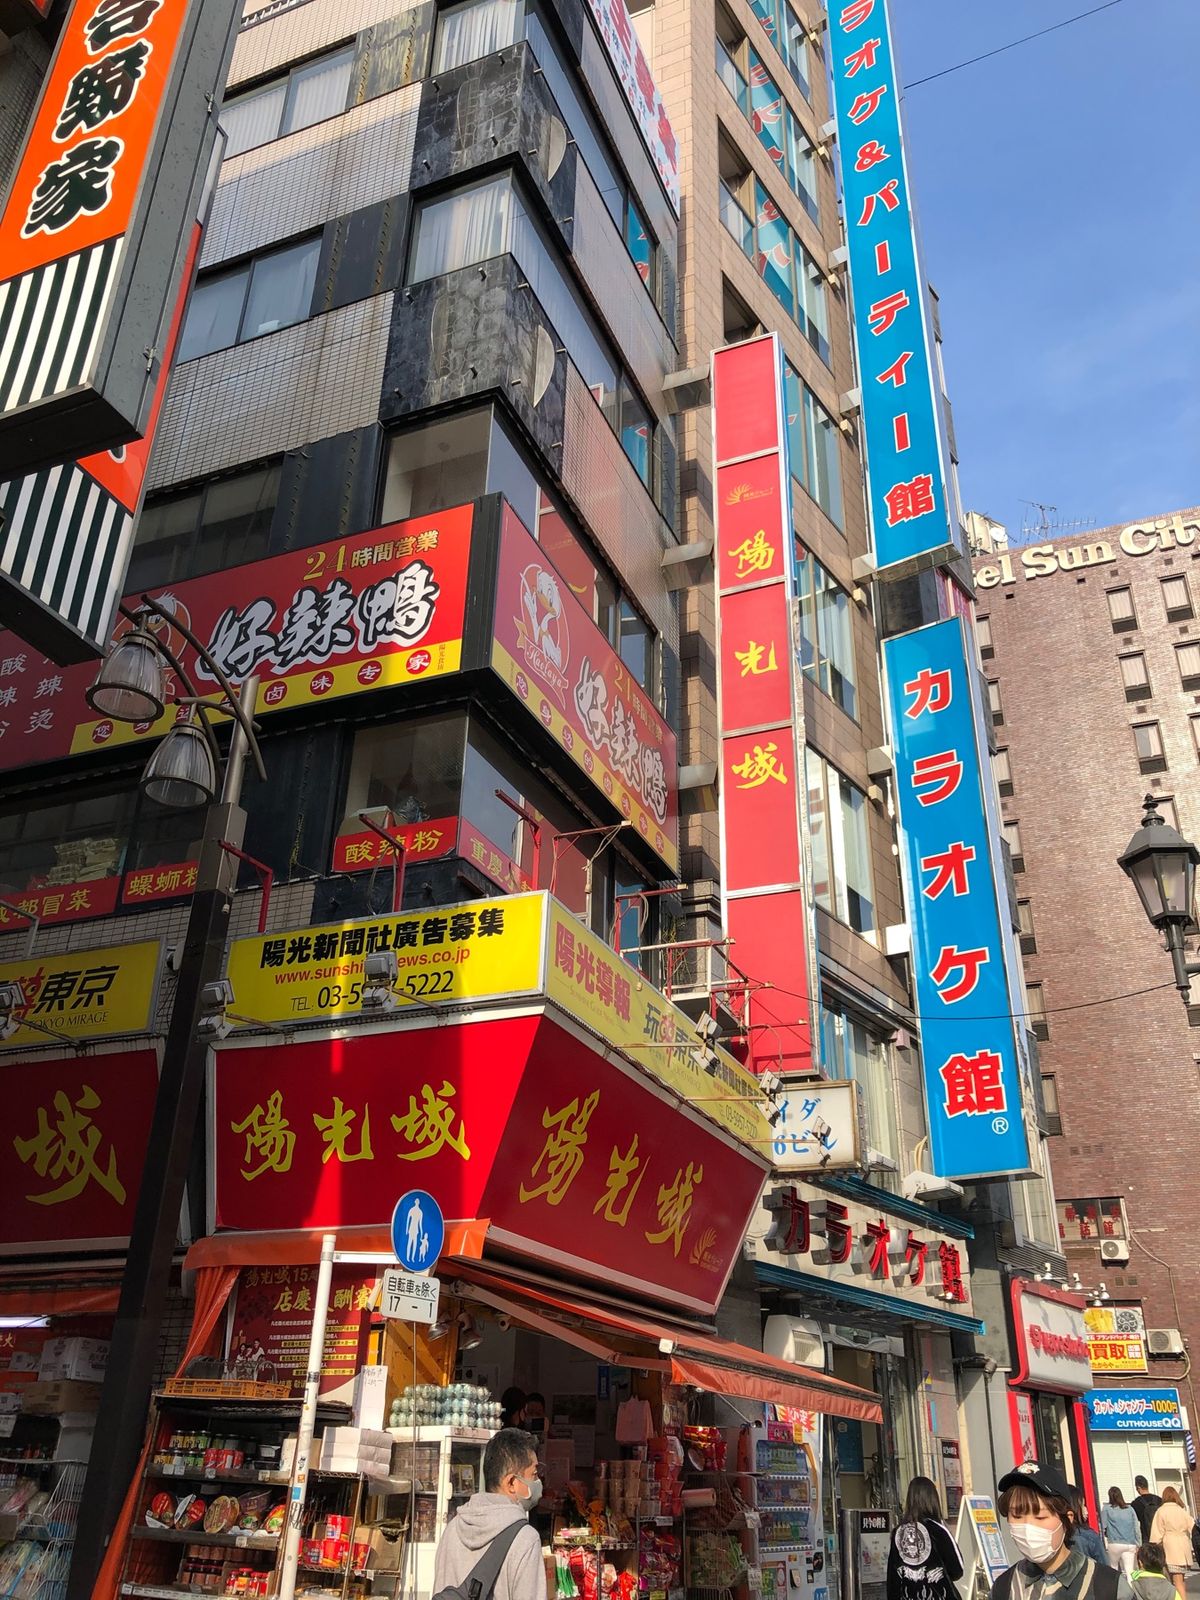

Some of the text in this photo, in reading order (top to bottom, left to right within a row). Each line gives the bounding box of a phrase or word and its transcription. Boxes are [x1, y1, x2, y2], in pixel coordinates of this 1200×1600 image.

[303, 530, 439, 580] 24時間営業
[973, 552, 1016, 589] el
[1021, 544, 1116, 580] Sun
[728, 530, 788, 789] 陽光城
[904, 668, 1008, 1119] カラオケ館
[231, 1080, 471, 1182] 陽光城
[519, 1088, 704, 1258] 陽光城
[273, 1283, 371, 1312] 店慶酬賓
[388, 1276, 437, 1299] 自転車を除く
[389, 1295, 401, 1312] 17
